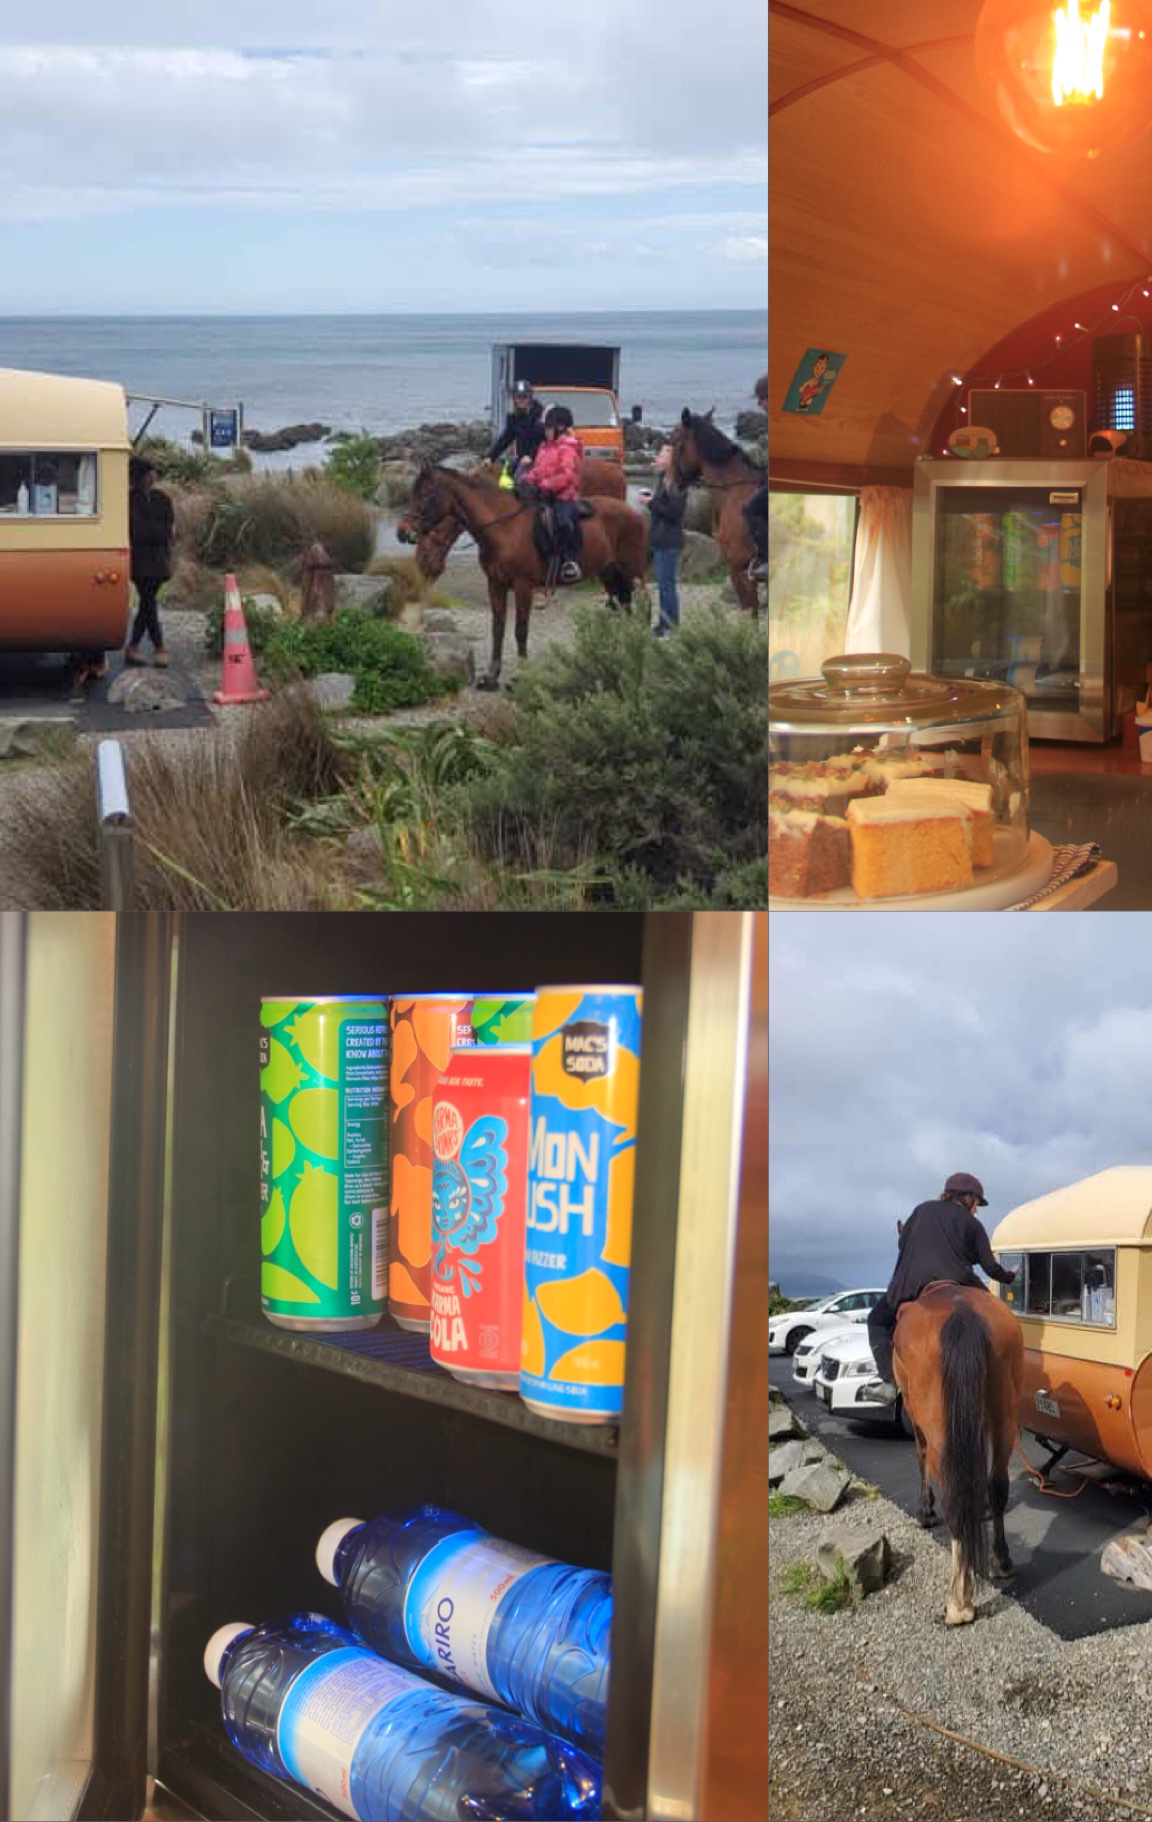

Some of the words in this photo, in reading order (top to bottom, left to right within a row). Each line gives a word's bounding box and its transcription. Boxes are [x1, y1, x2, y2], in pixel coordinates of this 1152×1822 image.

[345, 1025, 375, 1035] SERIOUS
[345, 1037, 374, 1047] CREATED
[345, 1049, 367, 1059] KNOW
[565, 1054, 606, 1073] SODA
[532, 1250, 568, 1271] FIZZER
[489, 1574, 515, 1602] 500ml
